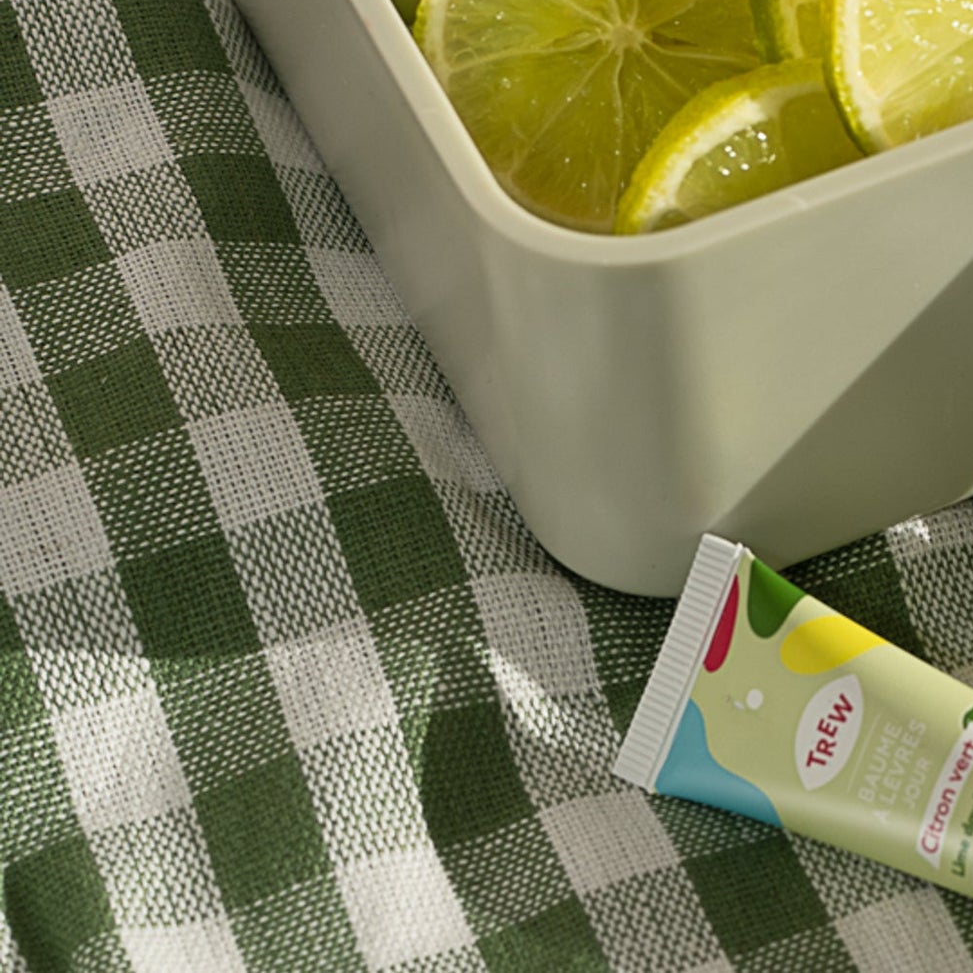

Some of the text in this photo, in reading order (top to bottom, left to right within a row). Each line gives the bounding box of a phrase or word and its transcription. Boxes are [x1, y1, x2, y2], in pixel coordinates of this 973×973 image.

[806, 693, 854, 769] TREW
[858, 721, 903, 803] BAUME
[903, 757, 931, 809] JOUR
[921, 787, 957, 854] Citron
[951, 839, 970, 878] Lime
